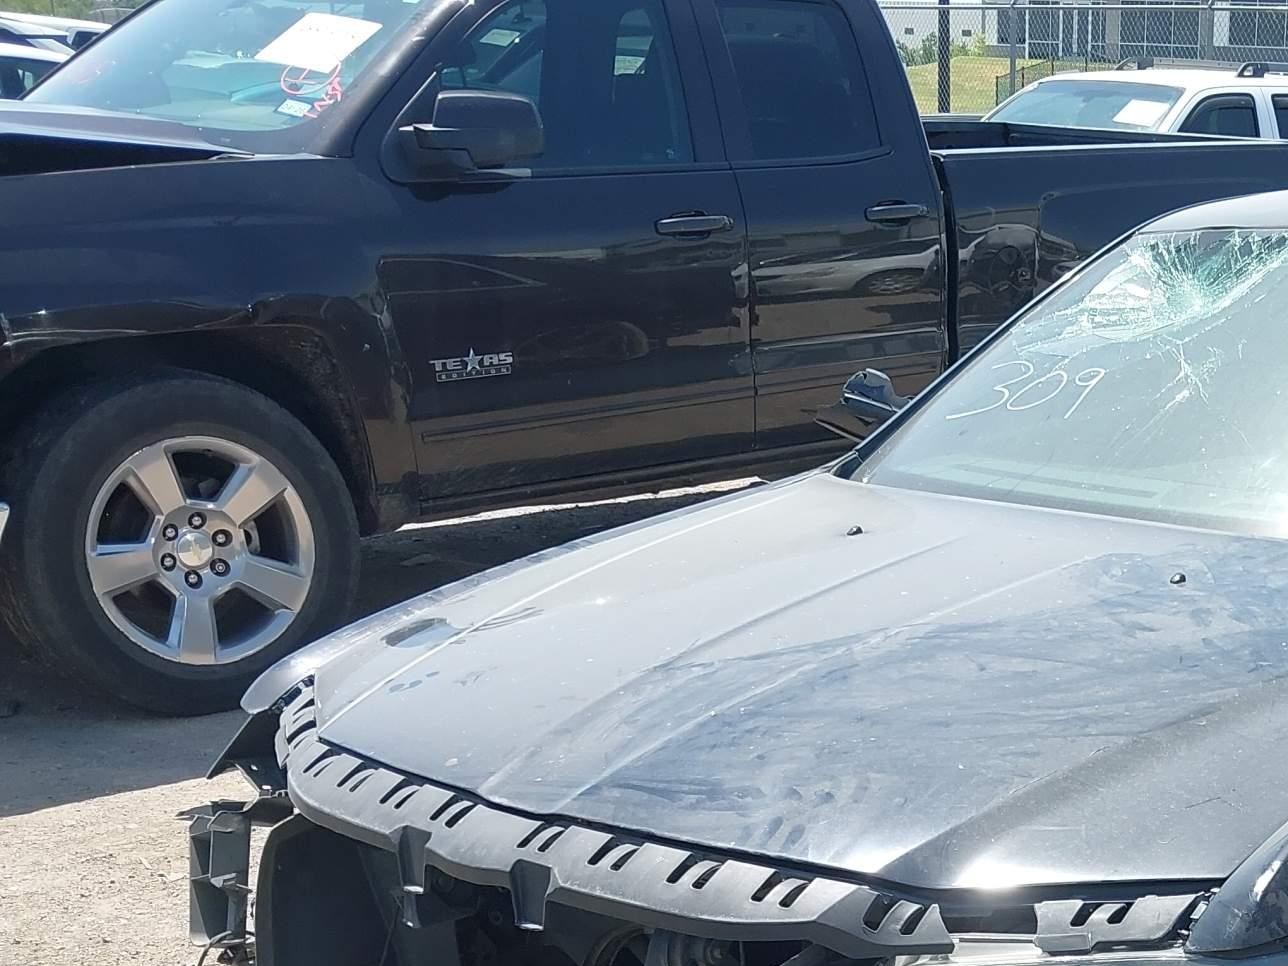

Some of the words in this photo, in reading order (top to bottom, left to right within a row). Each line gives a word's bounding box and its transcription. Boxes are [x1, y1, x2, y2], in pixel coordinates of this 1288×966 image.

[428, 347, 513, 372] TEXAS
[441, 366, 507, 379] EDITION
[945, 359, 1106, 420] 309
